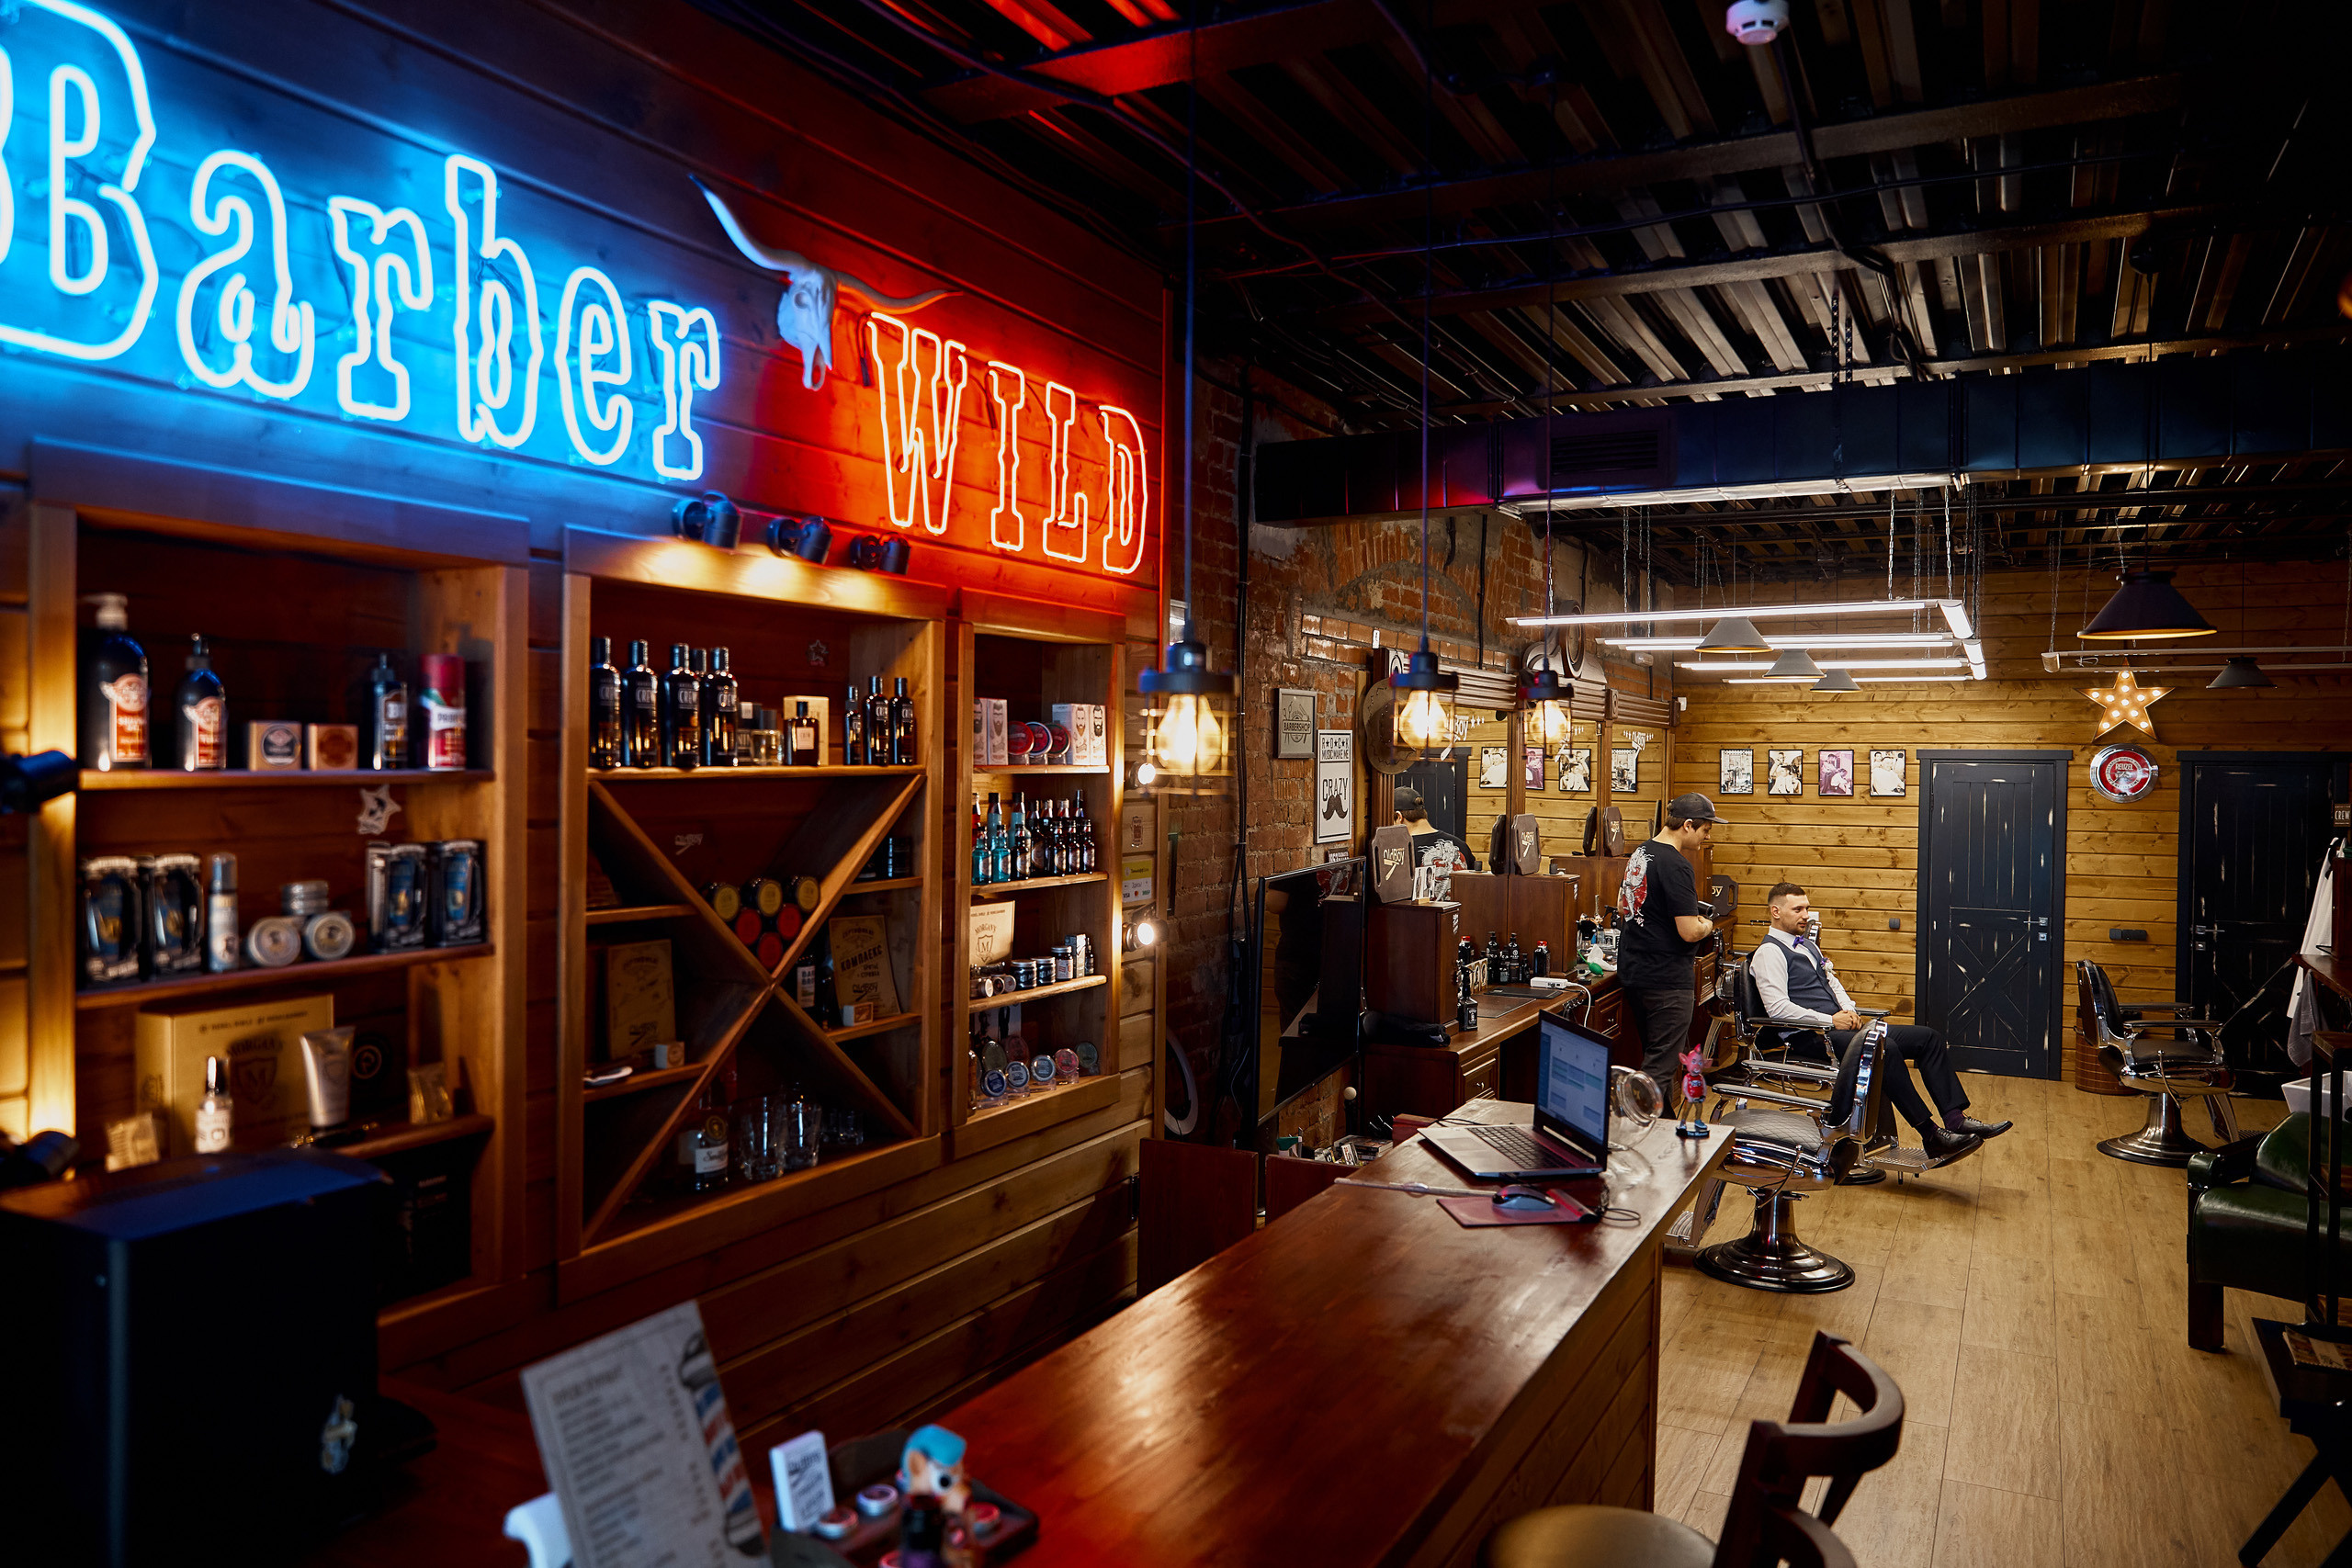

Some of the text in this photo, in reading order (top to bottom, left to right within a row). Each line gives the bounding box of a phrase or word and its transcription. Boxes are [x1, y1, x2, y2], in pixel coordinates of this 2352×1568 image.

[0, 0, 721, 482] Barber
[866, 311, 1148, 575] WILD
[1283, 722, 1310, 731] BARBERSHOP
[1322, 750, 1349, 760] MUSIC MAKE ME
[1322, 778, 1348, 802] CRAZY
[2335, 810, 2350, 819] CREW
[840, 944, 883, 972] КОМПЛЕКС
